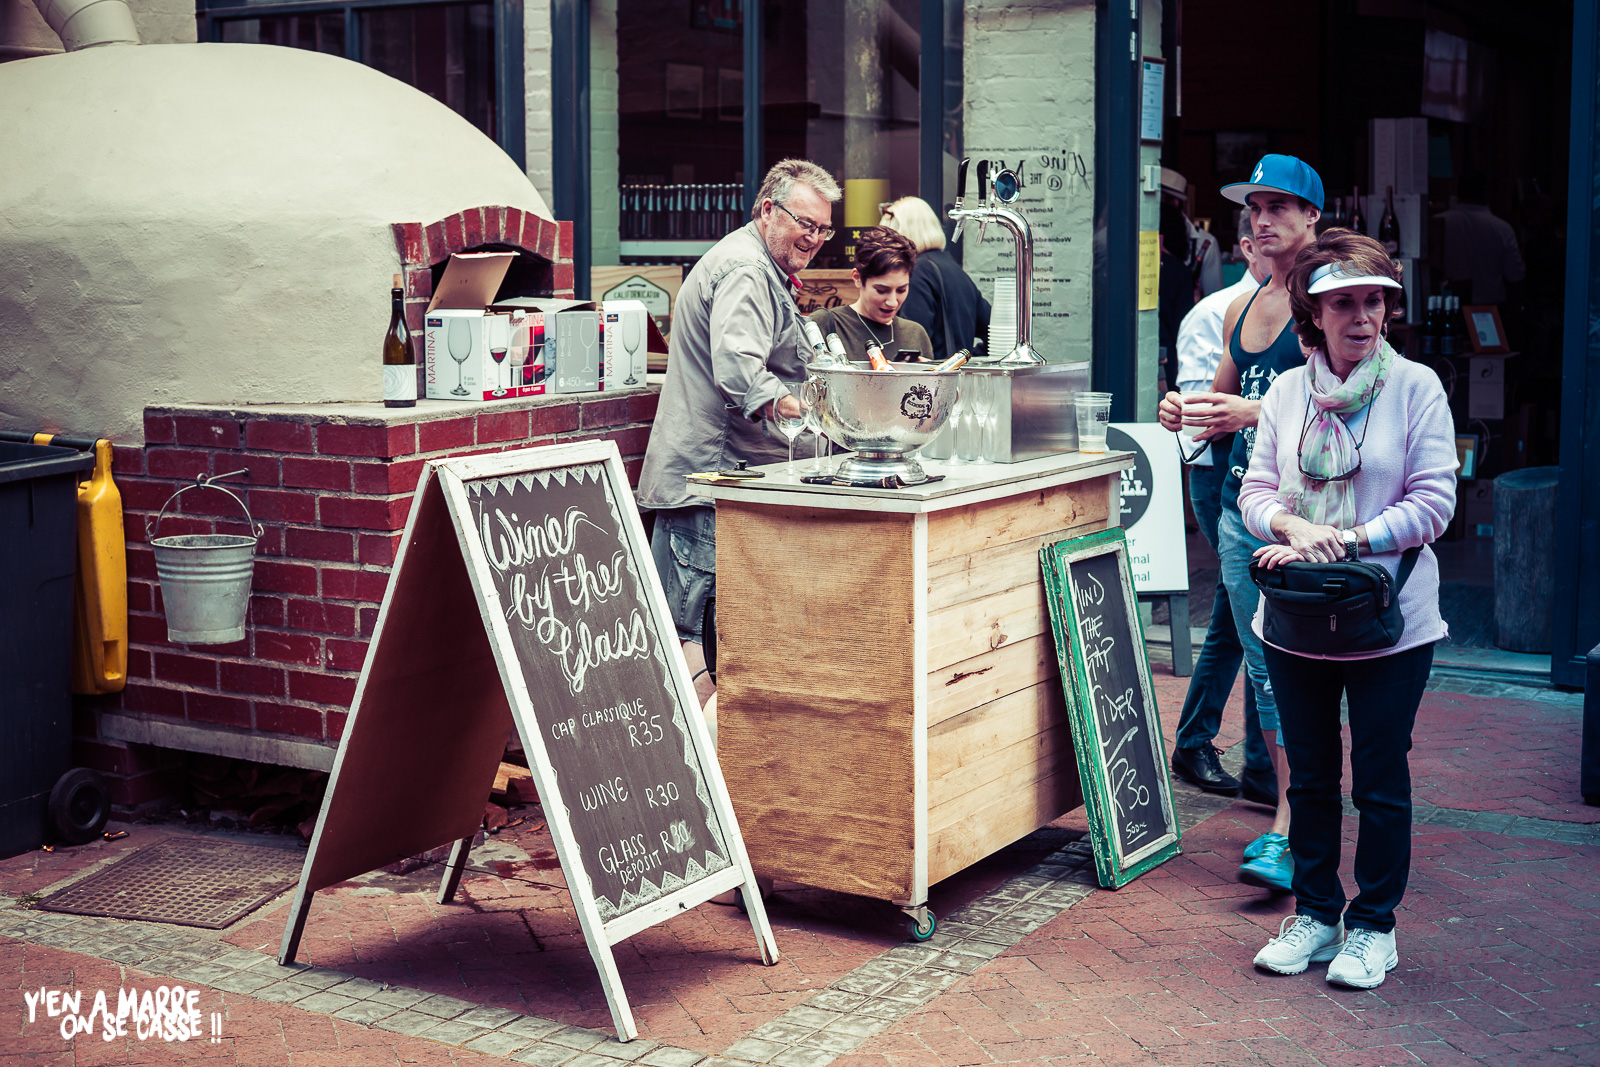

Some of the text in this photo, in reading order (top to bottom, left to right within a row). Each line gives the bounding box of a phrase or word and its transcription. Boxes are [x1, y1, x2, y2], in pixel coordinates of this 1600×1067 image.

[427, 330, 436, 384] MARTINA
[480, 502, 602, 578] Wine
[506, 550, 624, 644] by the
[1080, 614, 1103, 641] THE
[549, 608, 650, 697] Glass
[551, 697, 648, 740] CAP CLASSIQUE
[628, 714, 664, 748] R35
[579, 776, 680, 812] WINE R30
[1109, 757, 1150, 818] R30
[598, 833, 646, 876] GLASS
[619, 849, 663, 886] DEPOSIT
